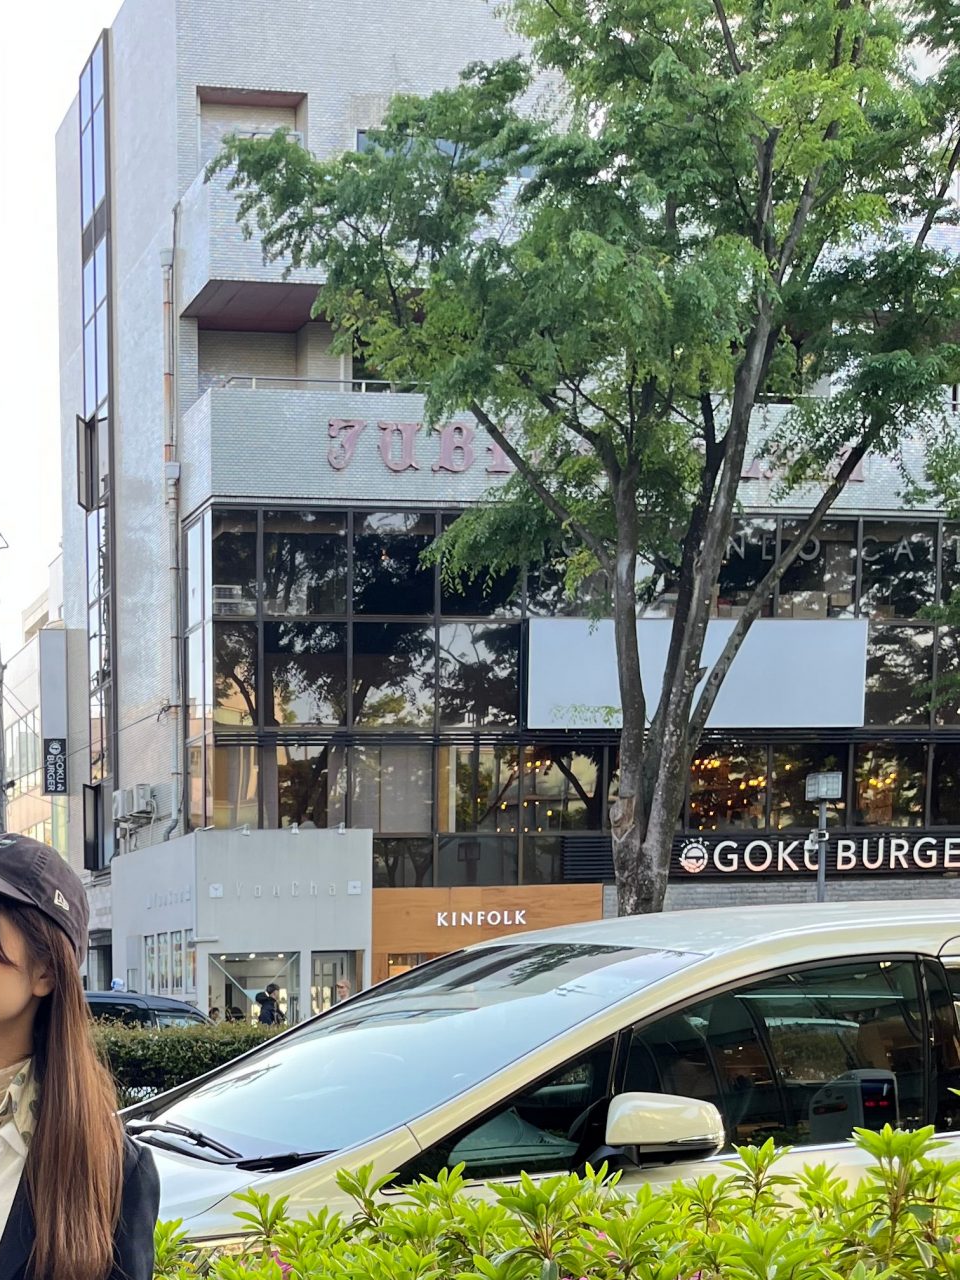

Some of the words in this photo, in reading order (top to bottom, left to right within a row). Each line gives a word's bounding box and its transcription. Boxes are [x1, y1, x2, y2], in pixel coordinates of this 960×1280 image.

[46, 754, 56, 791] BURGER
[56, 754, 65, 783] GOKU
[836, 837, 960, 871] BURGE
[436, 910, 527, 927] KINFOLK
